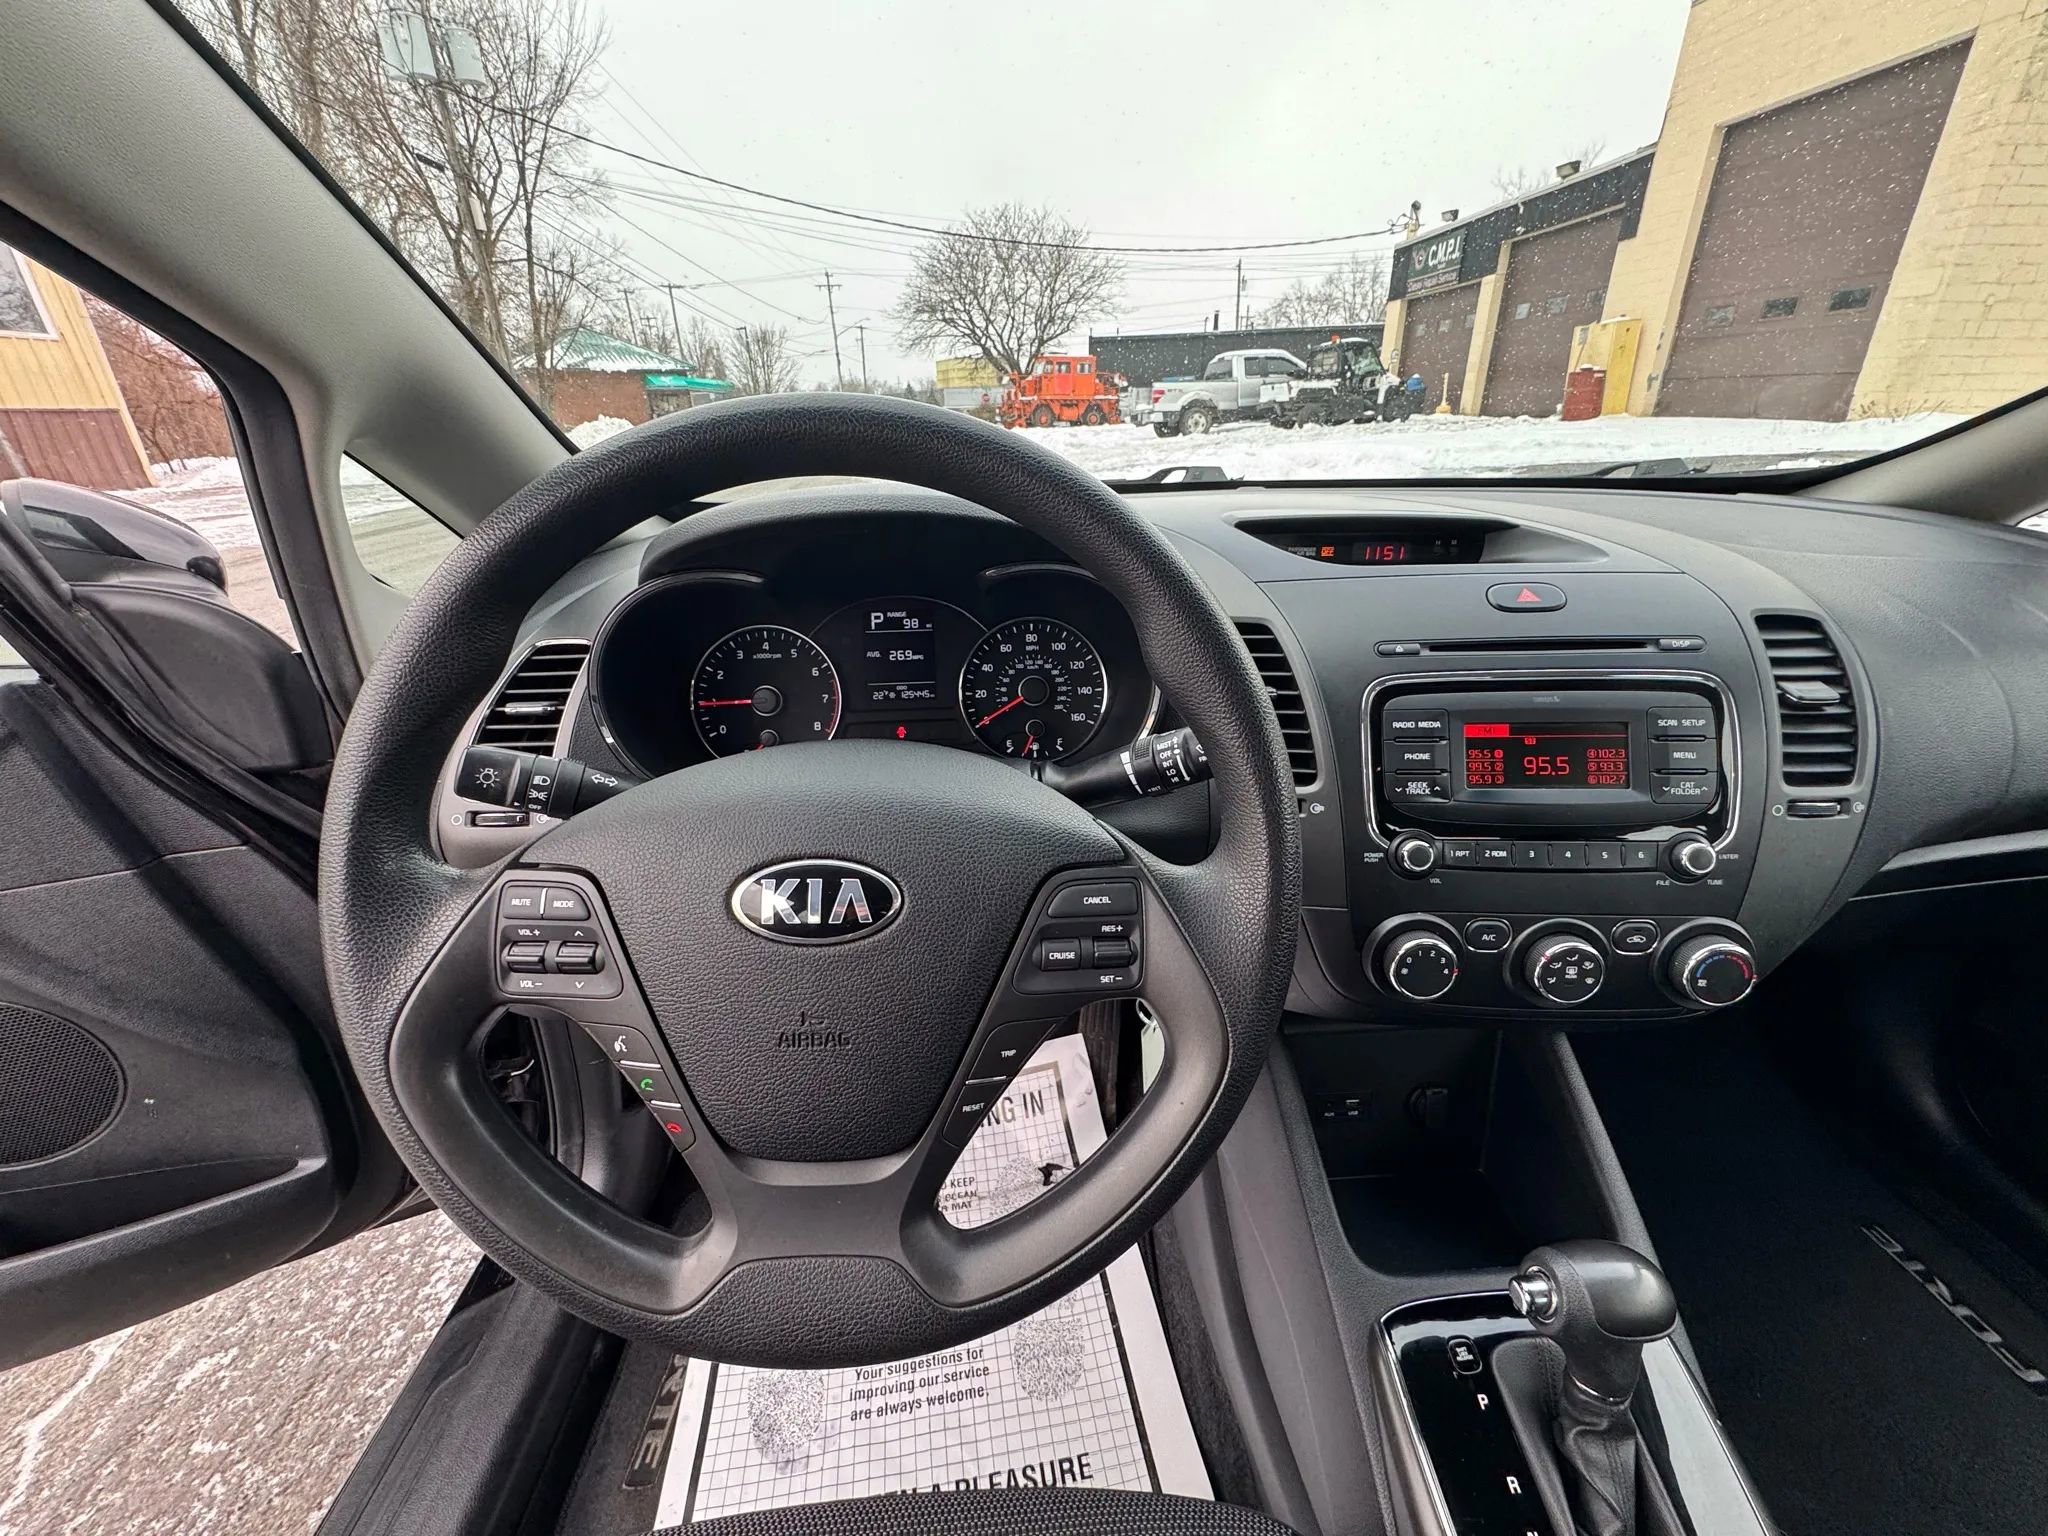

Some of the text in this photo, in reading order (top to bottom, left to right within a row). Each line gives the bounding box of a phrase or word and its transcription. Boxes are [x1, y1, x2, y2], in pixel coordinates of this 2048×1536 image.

[871, 613, 884, 629] P
[903, 619, 919, 629] 98
[1025, 634, 1038, 642] 80
[762, 642, 769, 650] 4
[1001, 644, 1012, 652] 60
[1051, 642, 1066, 650] 100
[737, 650, 743, 659] 3
[791, 649, 797, 658] 5
[982, 664, 993, 672] 40
[1070, 661, 1085, 669] 120
[717, 671, 724, 679] 2
[812, 667, 819, 676] 6
[975, 690, 987, 698] 20
[1077, 687, 1092, 695] 140
[822, 695, 829, 703] 7
[1071, 713, 1086, 721] 160
[720, 725, 726, 734] 0
[814, 722, 821, 730] 8
[1157, 740, 1172, 751] MIST
[1160, 750, 1172, 759] OFF
[1468, 750, 1491, 759] 95.5
[1597, 749, 1625, 758] 102.3
[1162, 760, 1173, 768] INT
[1524, 756, 1570, 775] 95.5
[1600, 762, 1623, 771] 93.3
[1469, 775, 1492, 784] 95.9
[1599, 775, 1625, 784] 102.7
[760, 878, 873, 925] KIA
[1083, 896, 1111, 904] CANCEL
[1049, 952, 1076, 960] CRUISE
[1001, 1049, 1016, 1058] TRIP
[962, 1102, 985, 1113] RESET
[981, 1090, 1045, 1128] NG IN
[950, 1176, 975, 1189] KEEP
[951, 1201, 972, 1211] MAT
[855, 1348, 983, 1381] Your suggestions for
[849, 1366, 990, 1402] improving our service
[1476, 1393, 1489, 1410] P
[850, 1408, 872, 1421] are
[876, 1398, 922, 1418] always
[1506, 1476, 1522, 1494] R
